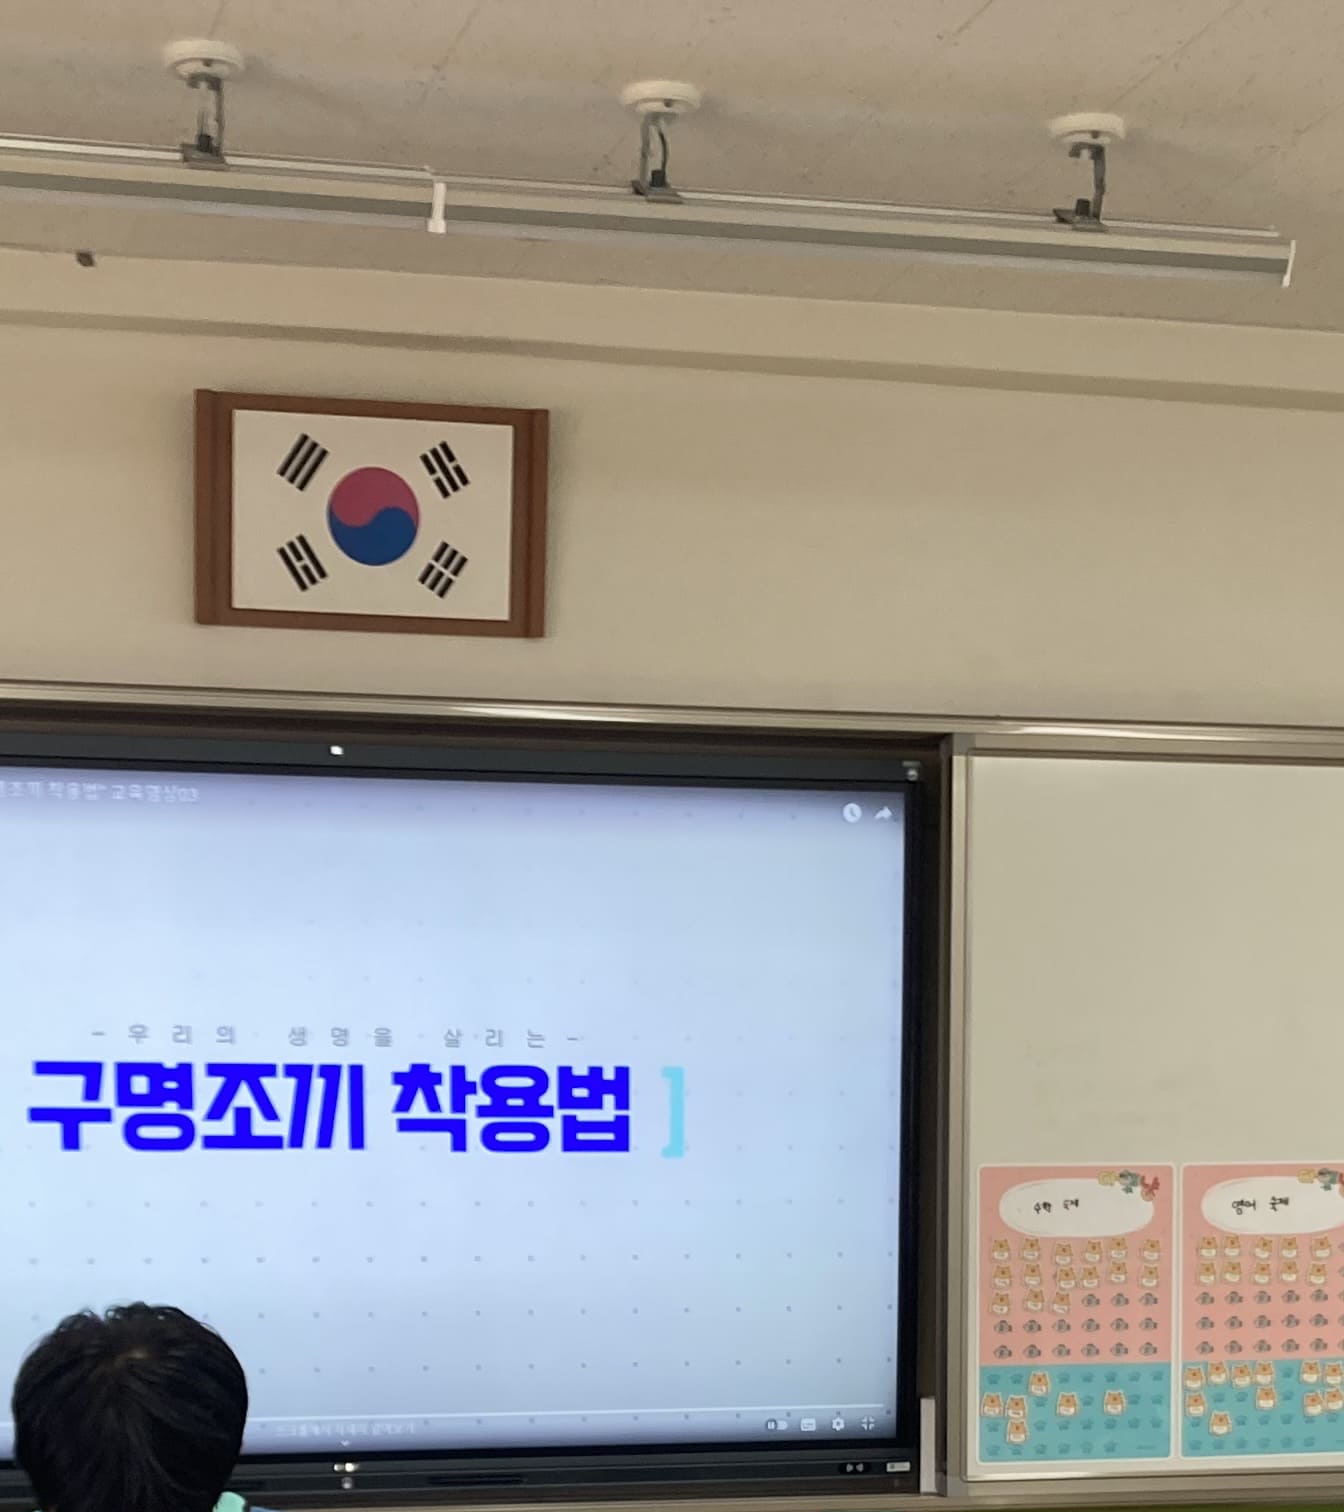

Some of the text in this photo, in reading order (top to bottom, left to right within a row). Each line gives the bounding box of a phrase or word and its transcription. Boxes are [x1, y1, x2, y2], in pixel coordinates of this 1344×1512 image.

[127, 1022, 547, 1050] 우리의 생명을 살리는
[27, 1060, 632, 1153] 구명조끼 착용법
